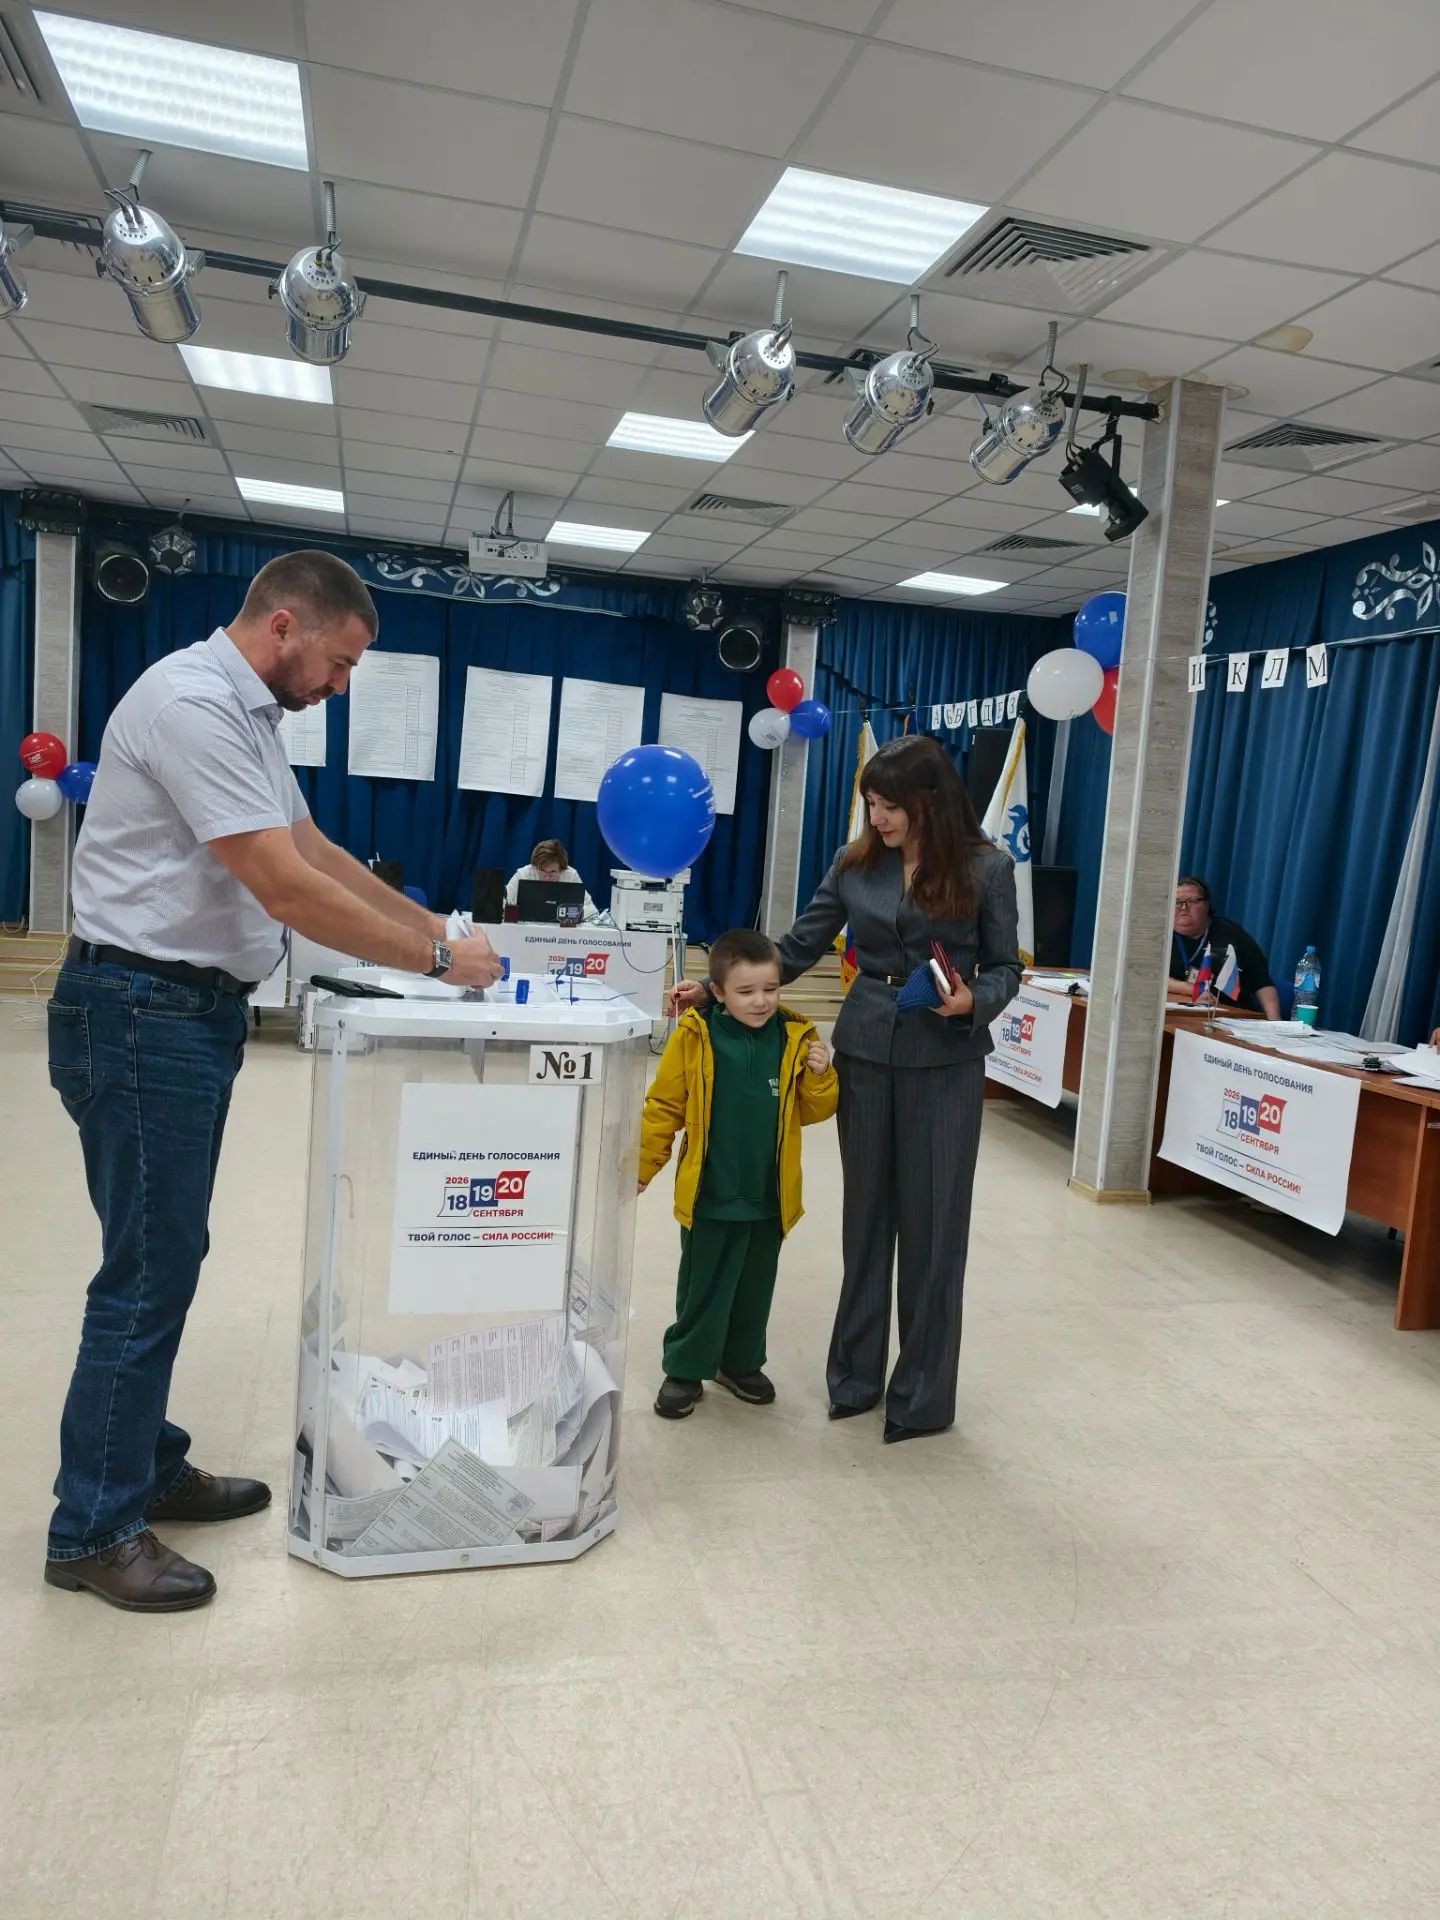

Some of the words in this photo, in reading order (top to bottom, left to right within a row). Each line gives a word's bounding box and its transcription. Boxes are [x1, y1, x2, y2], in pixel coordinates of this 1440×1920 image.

[1231, 662, 1246, 685] К
[1264, 657, 1286, 682] Л
[1308, 652, 1326, 681] М
[969, 705, 976, 723] Г
[982, 704, 992, 724] Д
[525, 935, 557, 944] ЕДИНЫЙ
[578, 939, 632, 948] ГОЛОСОВАНИЯ
[567, 962, 583, 975] 19
[586, 958, 605, 970] 20
[1002, 1027, 1010, 1042] 18
[1012, 1023, 1020, 1038] 19
[1021, 1020, 1033, 1035] 20
[536, 1051, 594, 1080] №1
[1204, 1053, 1232, 1070] ЕДИНЫЙ
[1233, 1062, 1253, 1076] ДЕНЬ
[1253, 1068, 1313, 1094] ГОЛОСОВАНИЯ
[1223, 1088, 1240, 1101] 2026
[1224, 1109, 1238, 1130] 18
[1241, 1104, 1257, 1126] 19
[1259, 1102, 1281, 1126] 20
[1240, 1132, 1280, 1156] СЕНТЯБРЯ
[458, 1152, 486, 1161] ДЕНЬ
[487, 1152, 561, 1161] ГОЛОСОВАНИЯ
[1196, 1142, 1214, 1157] ТВОЙ
[1215, 1151, 1238, 1167] ГОЛОС
[1245, 1163, 1266, 1179] СИЛА
[1267, 1172, 1302, 1194] РОССИИ!
[445, 1176, 469, 1185] 2026
[447, 1194, 468, 1211] 18
[472, 1185, 493, 1202] 19
[498, 1177, 523, 1194] 20
[472, 1209, 524, 1218] СЕНТЯБРЯ
[408, 1232, 435, 1242] ТВОЙ
[437, 1233, 471, 1242] ГОЛОС
[482, 1233, 509, 1241] СИЛА
[511, 1232, 554, 1240] РОССИИ!
